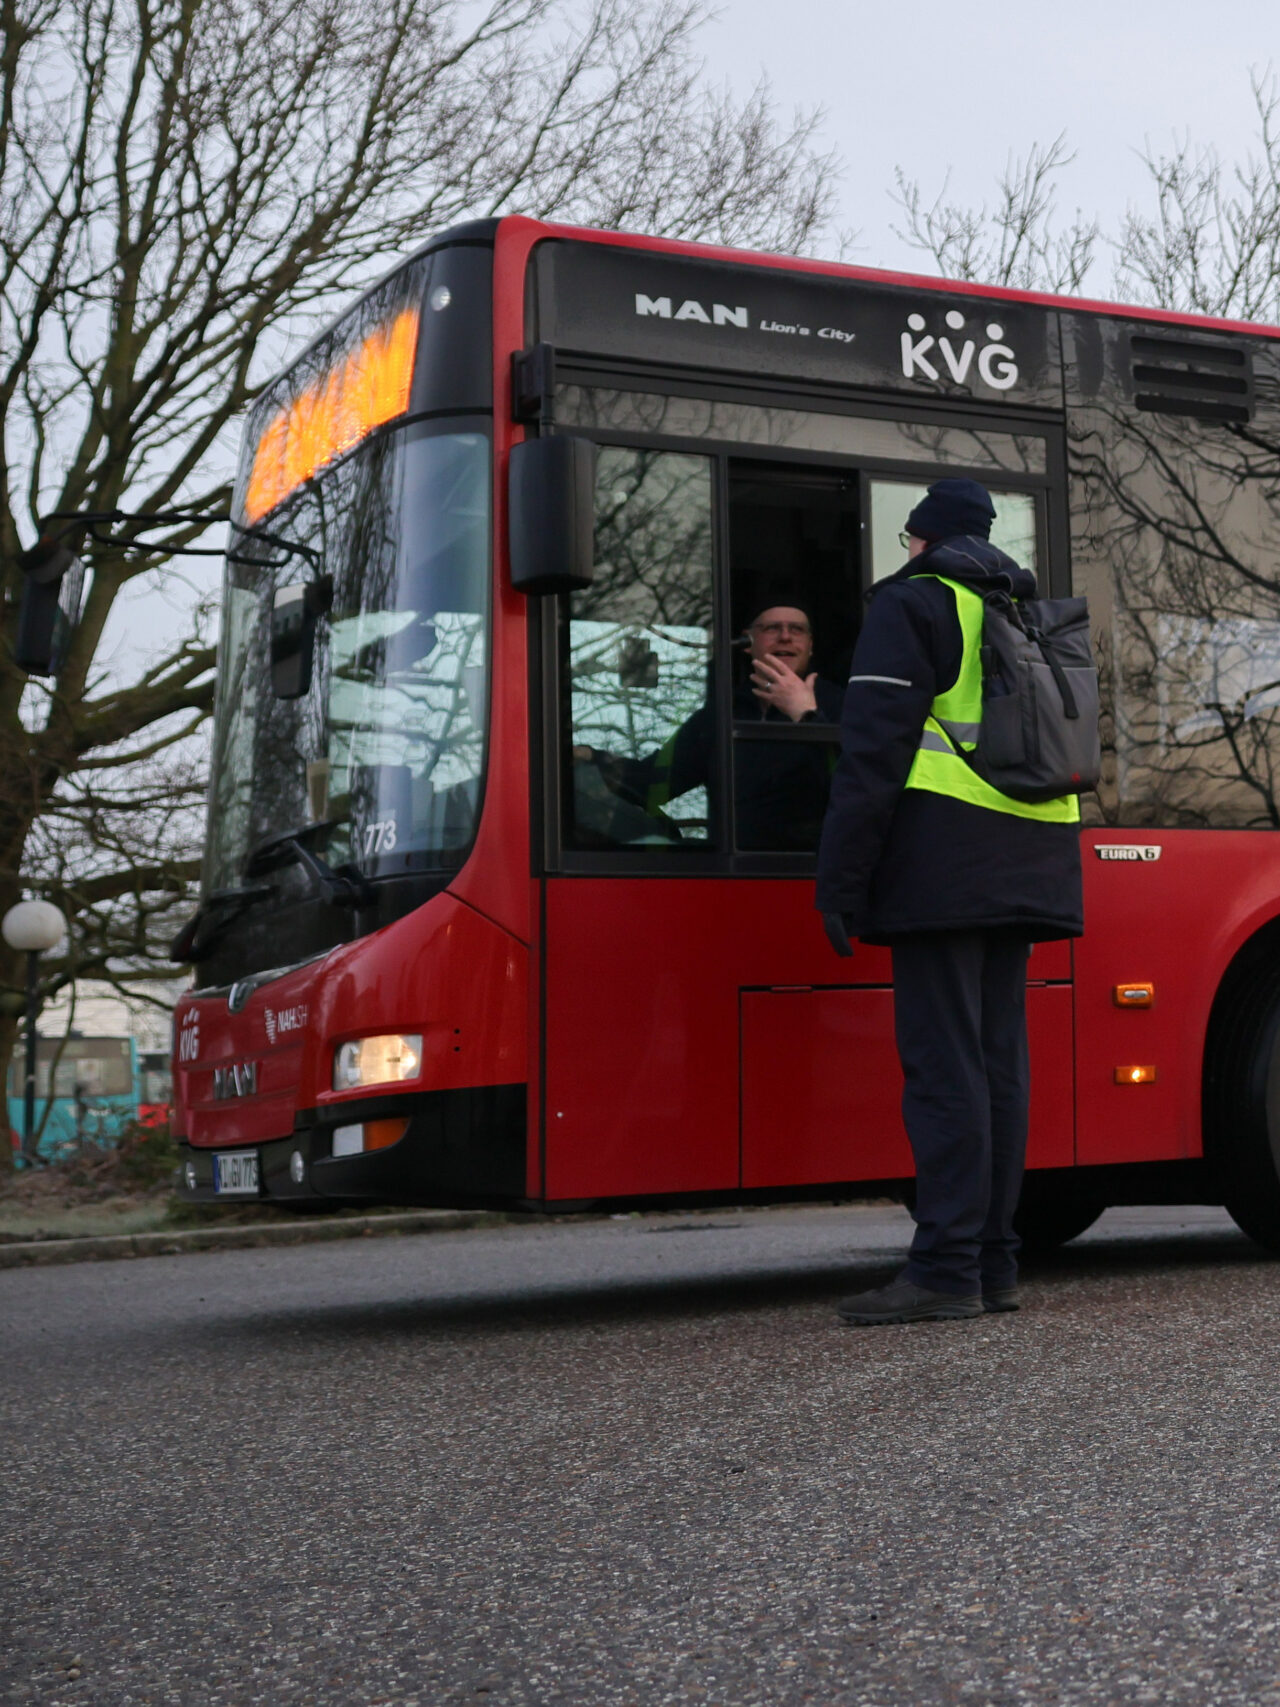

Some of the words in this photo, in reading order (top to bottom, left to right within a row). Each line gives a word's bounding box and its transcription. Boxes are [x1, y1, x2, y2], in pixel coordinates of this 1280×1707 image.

[635, 294, 748, 328] MAN
[760, 320, 810, 336] Lion's
[817, 328, 855, 343] City
[901, 332, 1018, 390] KVG
[365, 819, 397, 855] 773
[1100, 849, 1138, 860] EURO
[1145, 848, 1155, 859] 6
[179, 1026, 200, 1062] KVG
[214, 1062, 257, 1099] MAN
